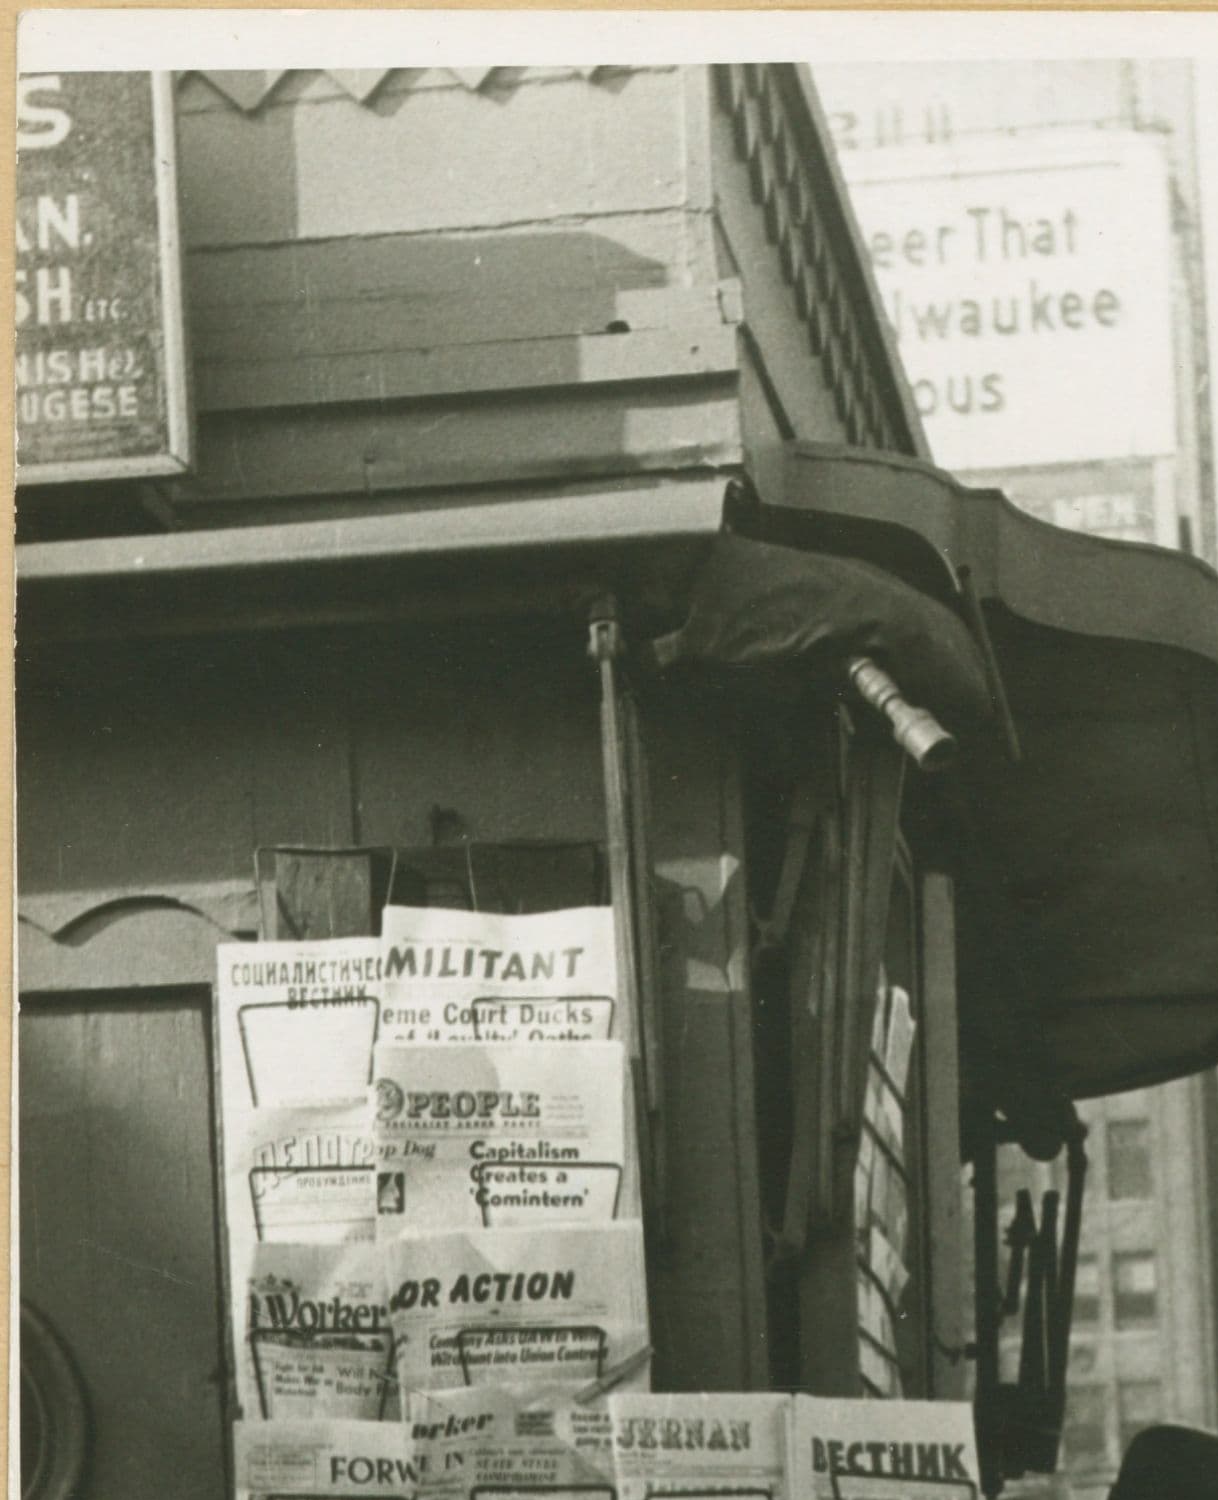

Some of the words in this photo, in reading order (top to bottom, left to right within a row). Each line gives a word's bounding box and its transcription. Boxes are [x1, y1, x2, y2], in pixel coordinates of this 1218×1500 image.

[872, 222, 957, 269] eer
[967, 206, 1079, 262] That
[20, 385, 138, 424] UGESE
[911, 371, 1007, 418] ous
[384, 945, 585, 982] MILITANT
[287, 985, 368, 1010] ВЕСТНИК
[443, 1002, 508, 1025] Court
[519, 1002, 594, 1025] Ducks
[406, 1090, 541, 1119] PEOPLE
[469, 1140, 580, 1163] Capitalism
[469, 1166, 548, 1185] Creates
[555, 1171, 568, 1185] a
[469, 1188, 590, 1209] 'Comintern'
[449, 1270, 575, 1304] ACTION
[811, 1436, 970, 1479] ВЕСТНИК
